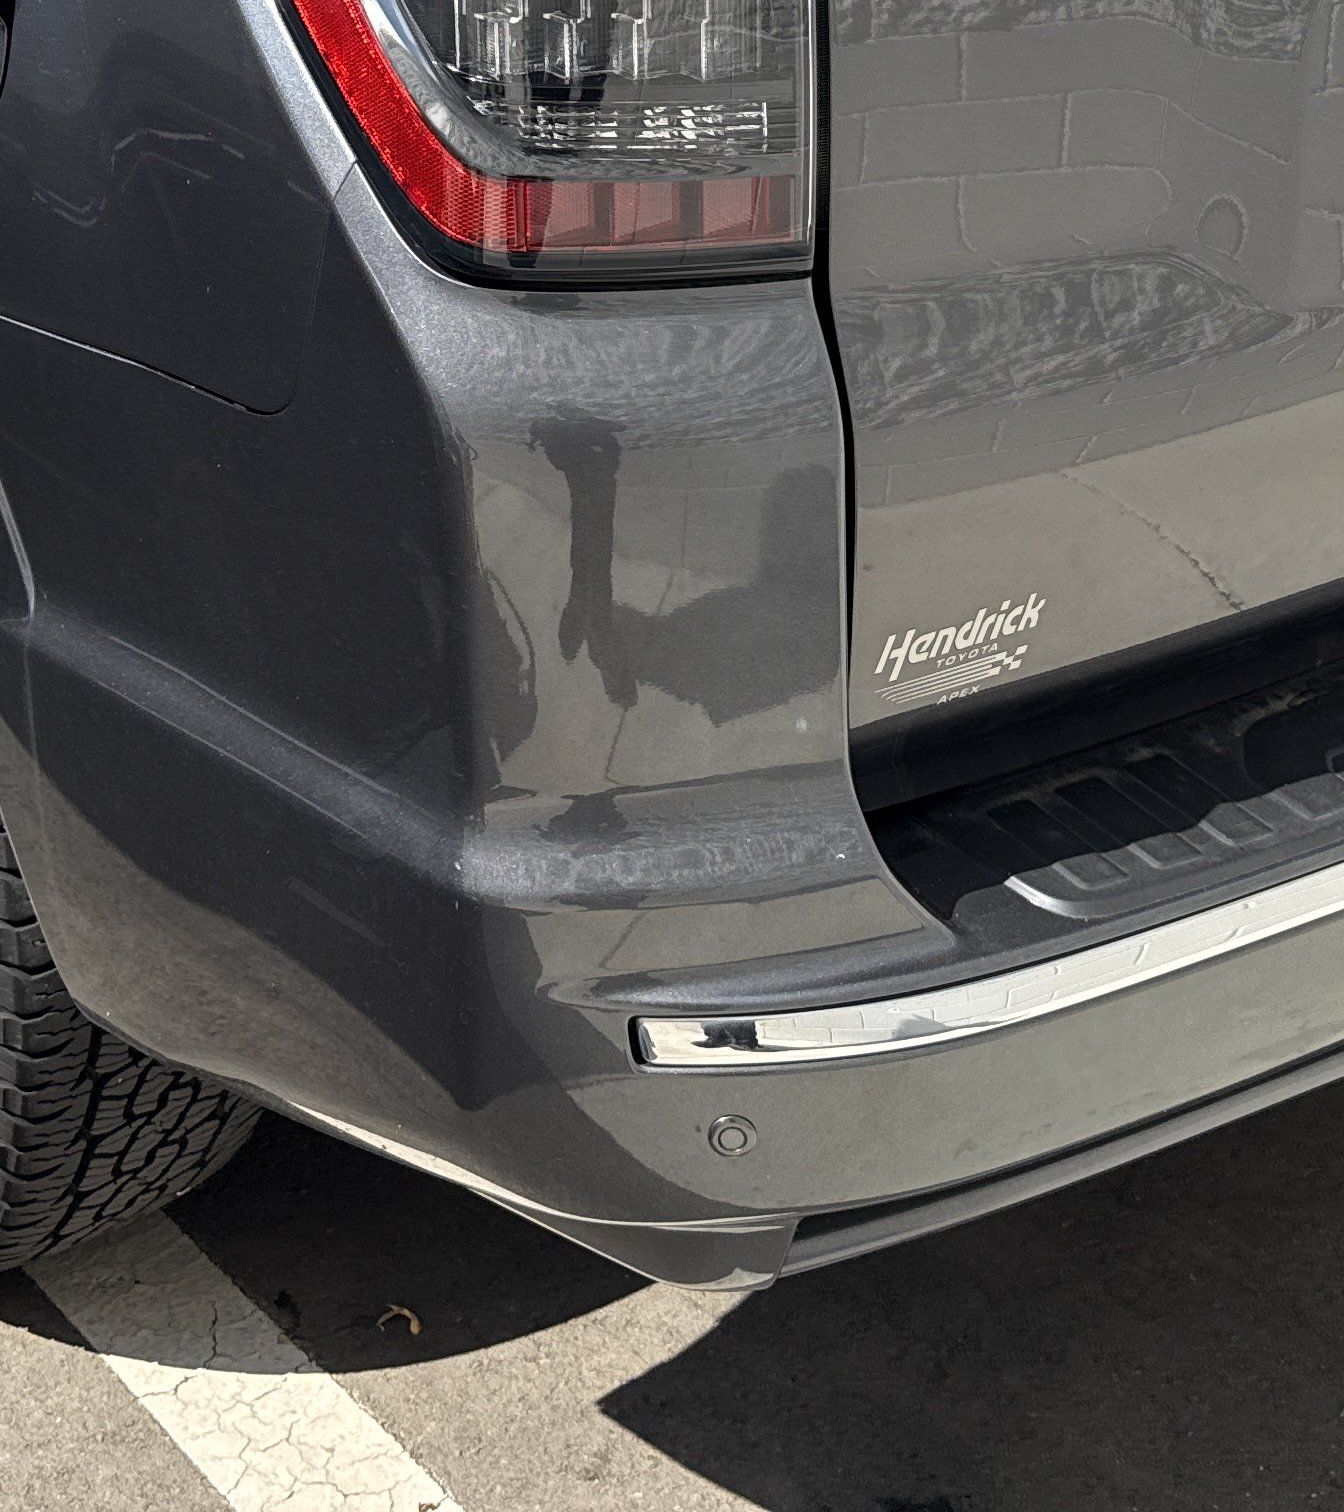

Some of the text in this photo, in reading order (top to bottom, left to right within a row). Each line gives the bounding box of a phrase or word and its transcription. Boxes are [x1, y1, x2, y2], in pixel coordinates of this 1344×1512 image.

[873, 592, 1047, 682] Hendrick
[936, 642, 999, 669] TOYOTA
[936, 684, 981, 705] APEX
